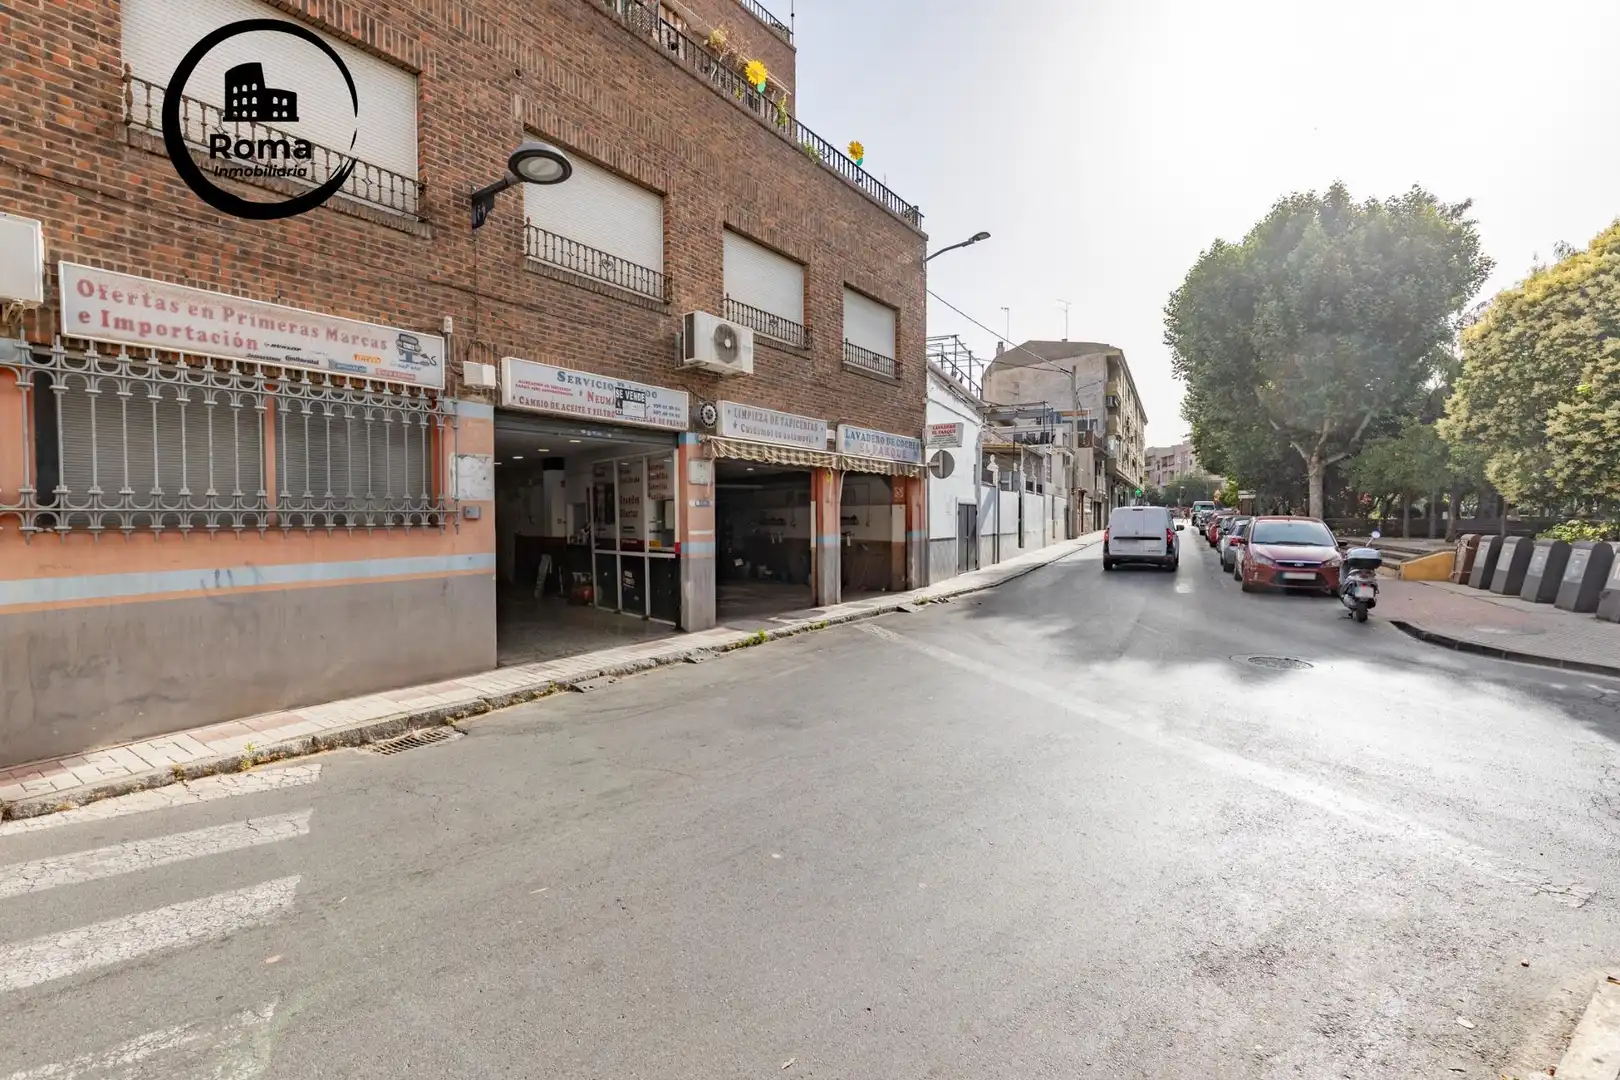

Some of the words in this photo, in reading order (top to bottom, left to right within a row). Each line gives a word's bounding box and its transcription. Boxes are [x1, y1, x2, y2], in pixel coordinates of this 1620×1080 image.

[77, 279, 179, 314] Ofertas
[188, 305, 214, 320] en
[222, 306, 319, 338] Primeras
[326, 328, 388, 350] Marcas
[78, 310, 91, 324] e
[101, 309, 258, 351] Importación
[557, 371, 614, 391] SERVICIO
[616, 388, 624, 399] SE
[624, 390, 646, 403] VENDE
[519, 396, 548, 408] CAMBIO
[550, 401, 560, 410] DE
[561, 404, 586, 413] ACEITE
[734, 408, 768, 424] LIMPIEZA
[845, 428, 885, 444] LAVADERO
[886, 437, 895, 446] DE
[860, 442, 870, 454] EL
[871, 444, 908, 459] PARQUE
